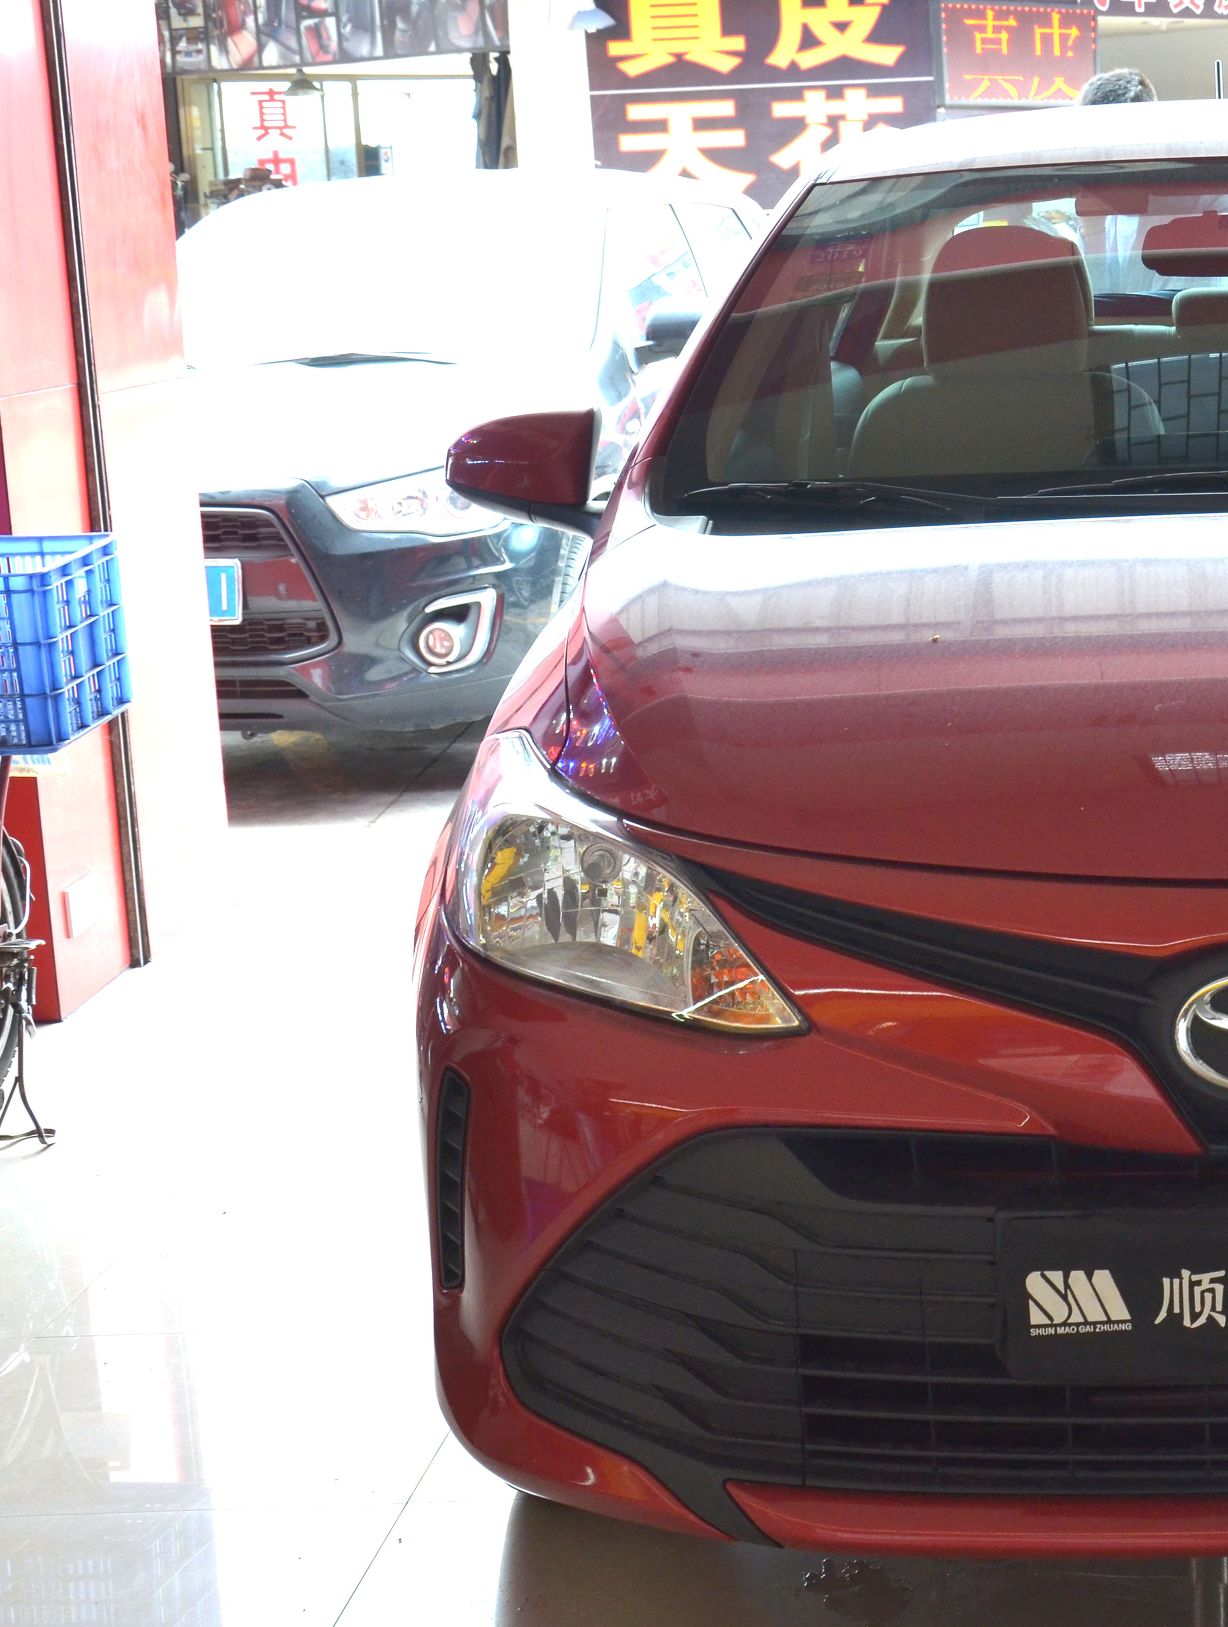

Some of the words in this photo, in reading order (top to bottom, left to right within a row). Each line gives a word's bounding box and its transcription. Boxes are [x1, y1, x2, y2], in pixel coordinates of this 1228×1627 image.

[606, 0, 907, 79] 真皮
[1030, 1327, 1055, 1337] SHUN
[1057, 1325, 1077, 1334] MAO
[1078, 1324, 1094, 1333] GAI
[1095, 1322, 1132, 1332] ZHUANG
